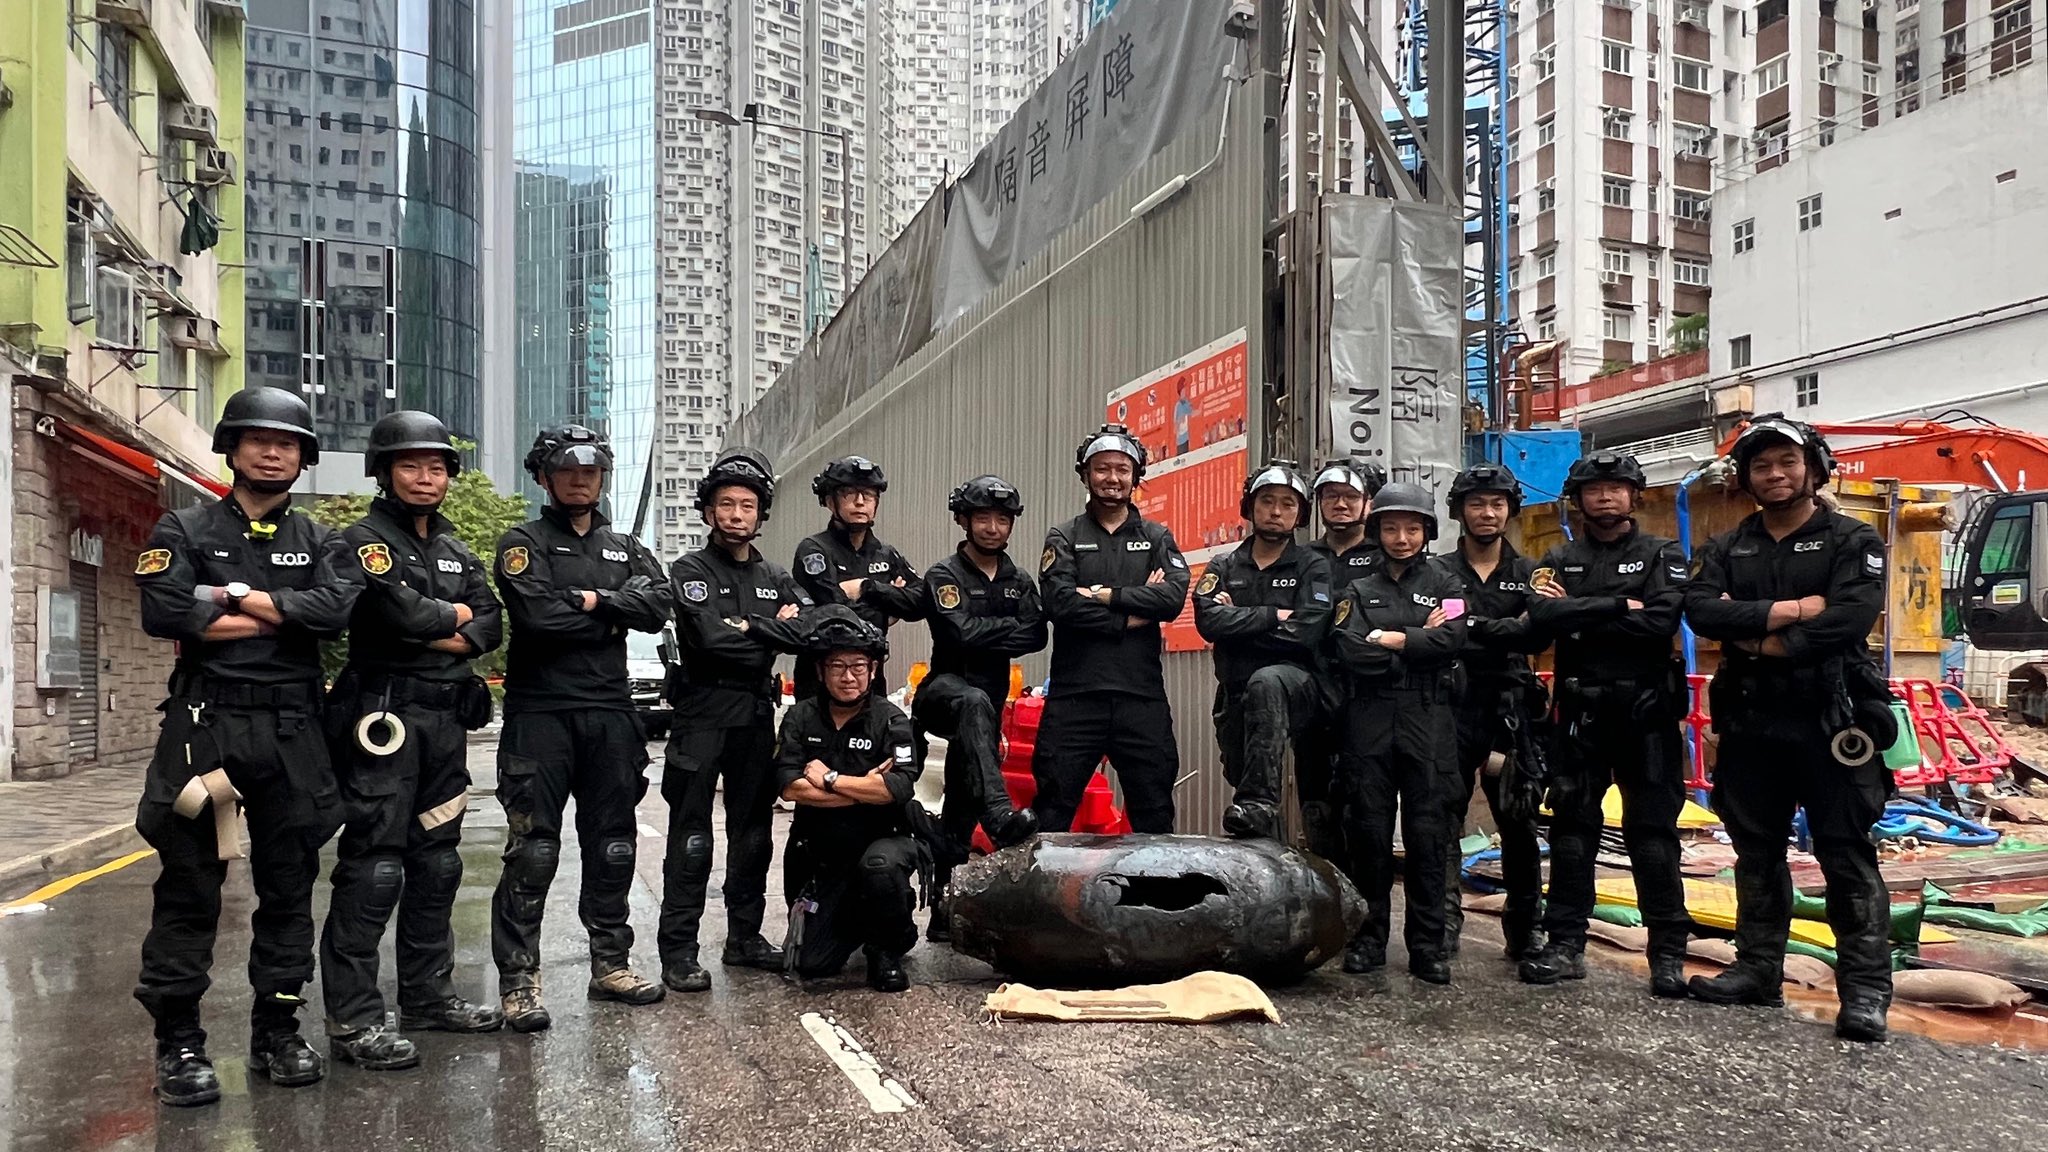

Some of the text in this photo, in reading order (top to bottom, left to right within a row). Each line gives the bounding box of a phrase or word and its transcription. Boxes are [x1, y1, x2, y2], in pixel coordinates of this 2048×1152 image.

[994, 32, 1135, 212] 隔音屏障
[1348, 387, 1383, 457] Noi
